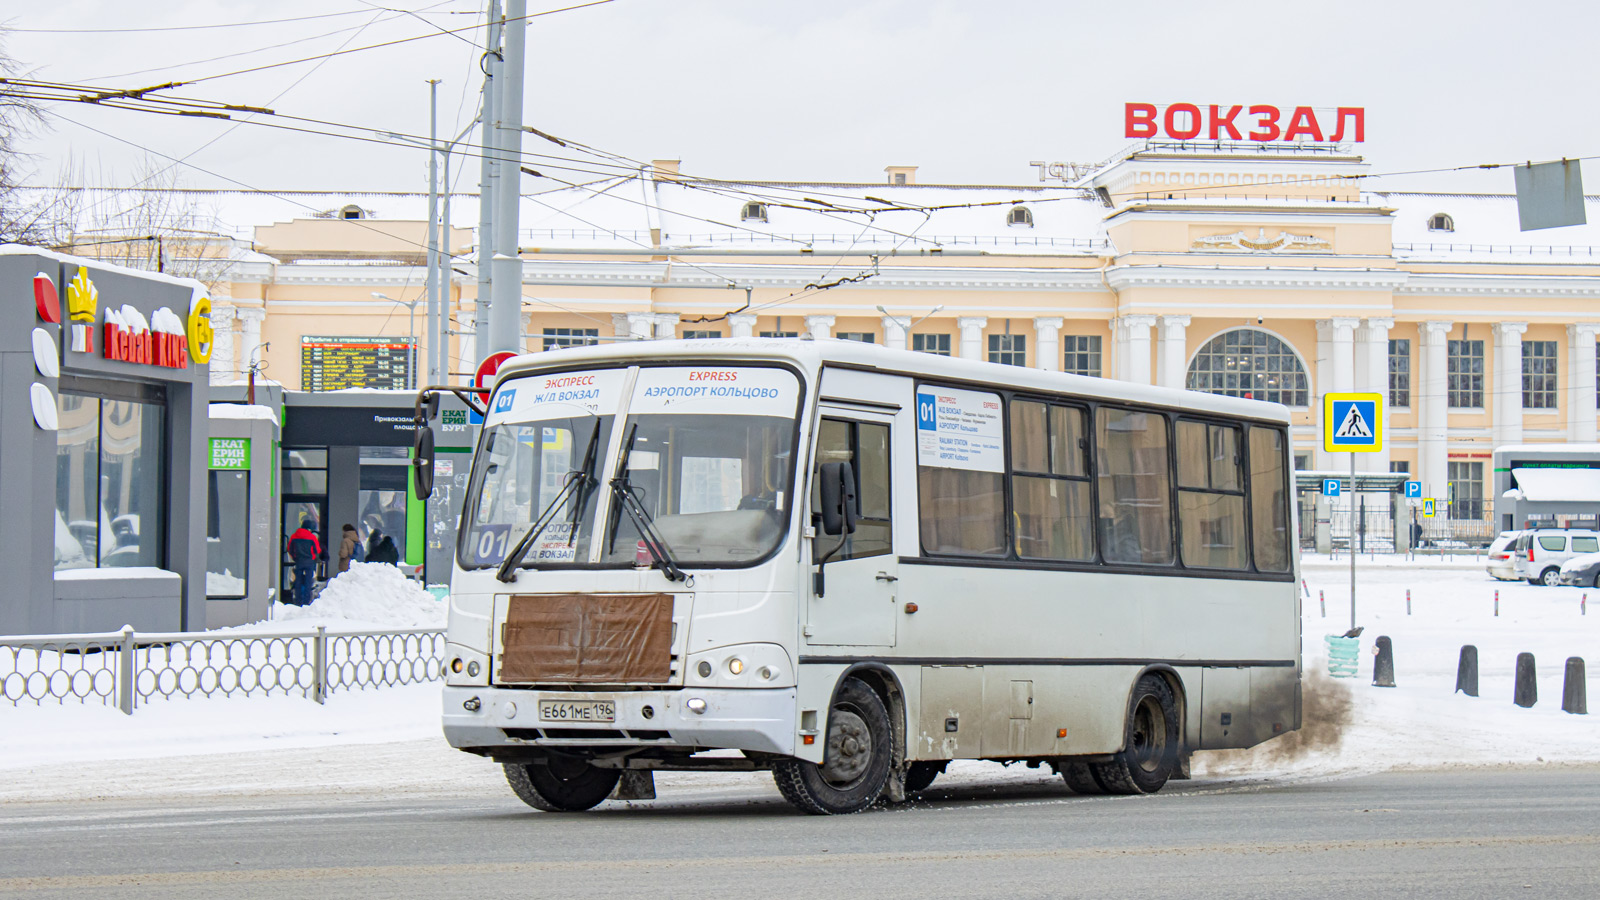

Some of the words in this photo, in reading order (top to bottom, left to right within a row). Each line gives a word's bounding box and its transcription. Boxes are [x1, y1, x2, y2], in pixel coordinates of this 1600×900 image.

[1125, 102, 1365, 142] ВОКЗАЛ
[105, 321, 153, 365] Kebab
[544, 375, 595, 389] ЭКСПРЕСС
[689, 371, 738, 381] EXPRESS
[558, 388, 600, 401] ВОКЗАЛ
[644, 386, 707, 397] АЭРОПОРТ
[709, 387, 779, 399] КОЛЬЦОВО
[499, 394, 513, 408] 01
[442, 409, 467, 417] ЕКАТ
[921, 402, 934, 422] 01
[442, 424, 467, 432] БУРГ
[213, 439, 246, 448] ЕКАТ
[213, 448, 245, 458] ЕРИН
[213, 457, 246, 467] БУРГ
[1328, 481, 1338, 494] P
[1409, 483, 1419, 496] P
[479, 530, 508, 558] 01
[539, 550, 574, 558] ВОКЗАЛ
[544, 703, 591, 719] Е661МЕ
[593, 703, 613, 715] 196
